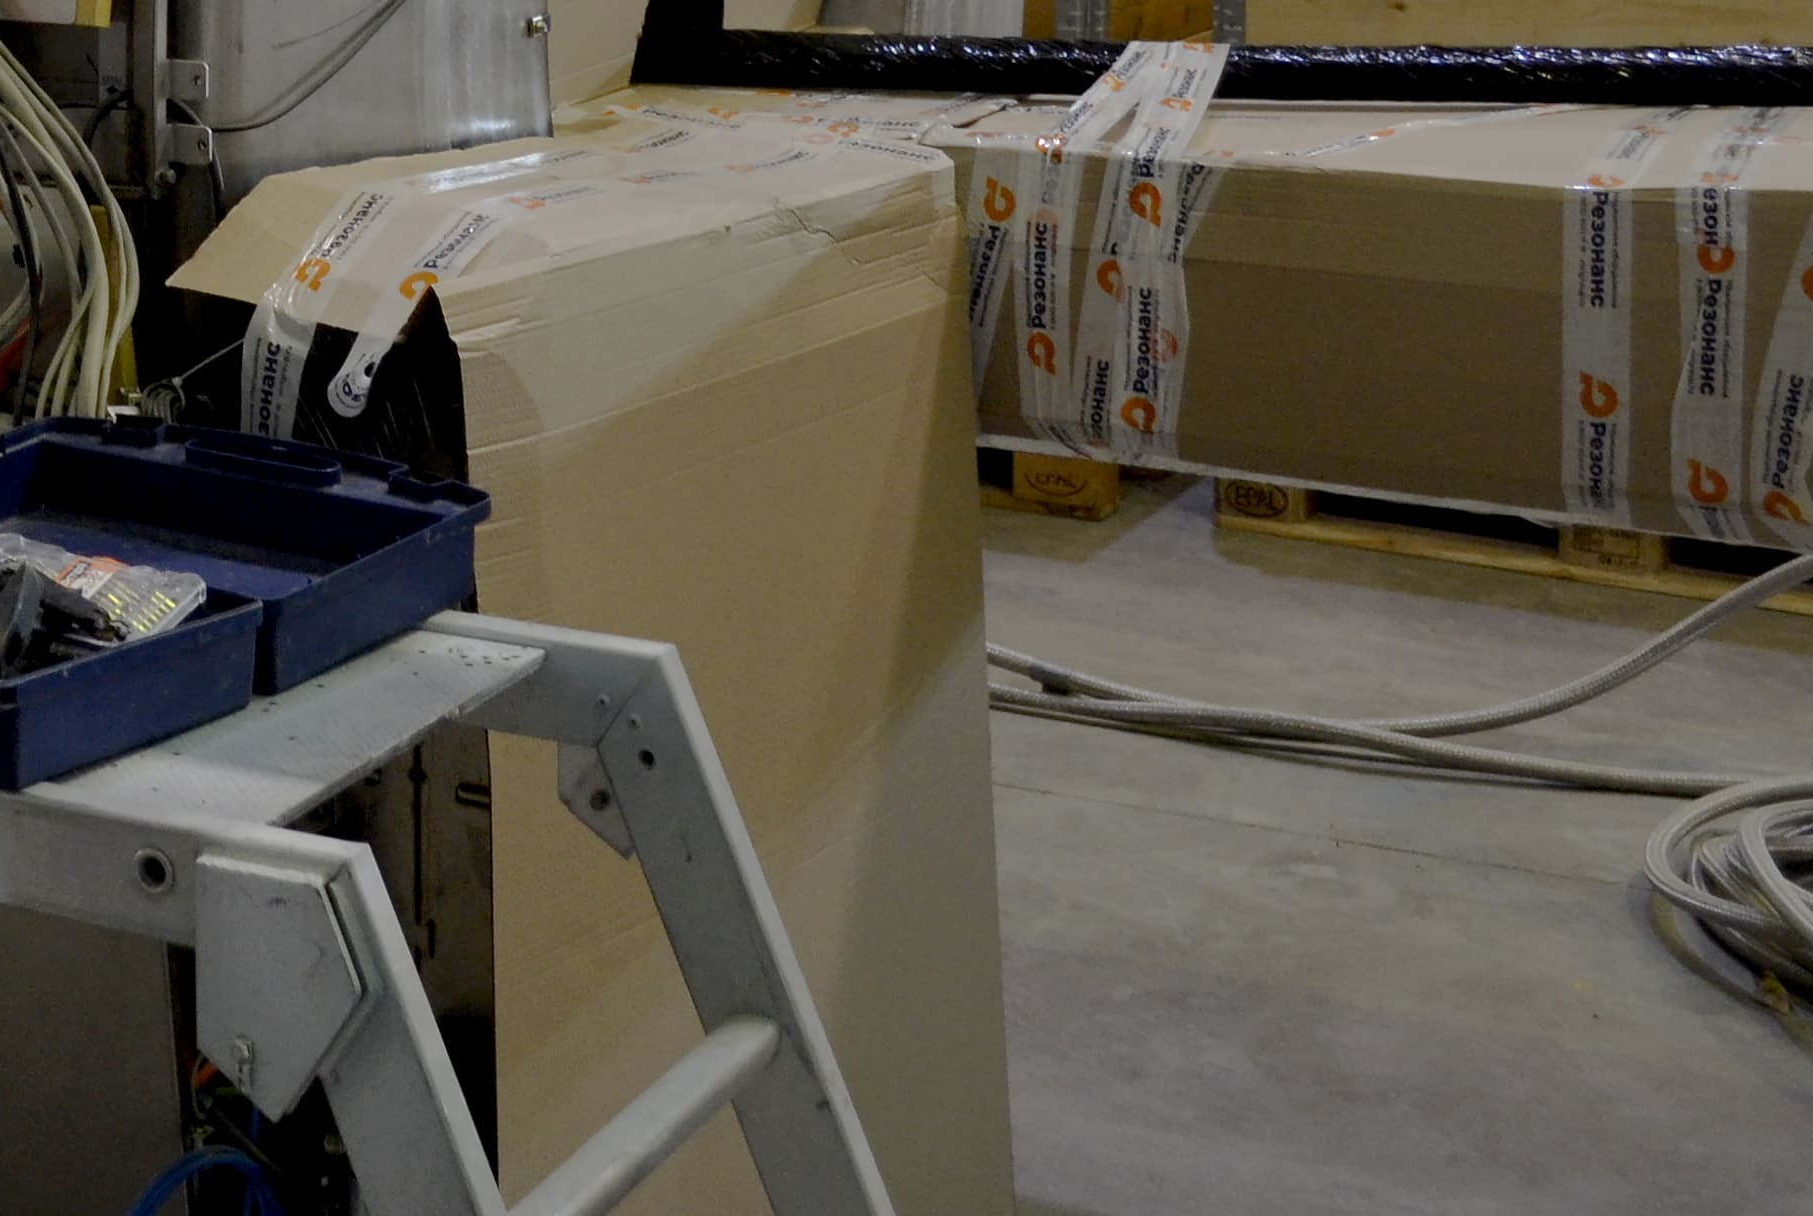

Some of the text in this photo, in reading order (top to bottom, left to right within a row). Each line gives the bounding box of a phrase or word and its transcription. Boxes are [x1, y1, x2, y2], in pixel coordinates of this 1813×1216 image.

[1032, 222, 1048, 330] Резонанс
[1590, 191, 1609, 309] Резонанс
[258, 341, 281, 436] зонанс
[1132, 287, 1152, 394] Резонанс
[1700, 278, 1722, 397] Резонанс
[1772, 372, 1805, 490] Резонанс
